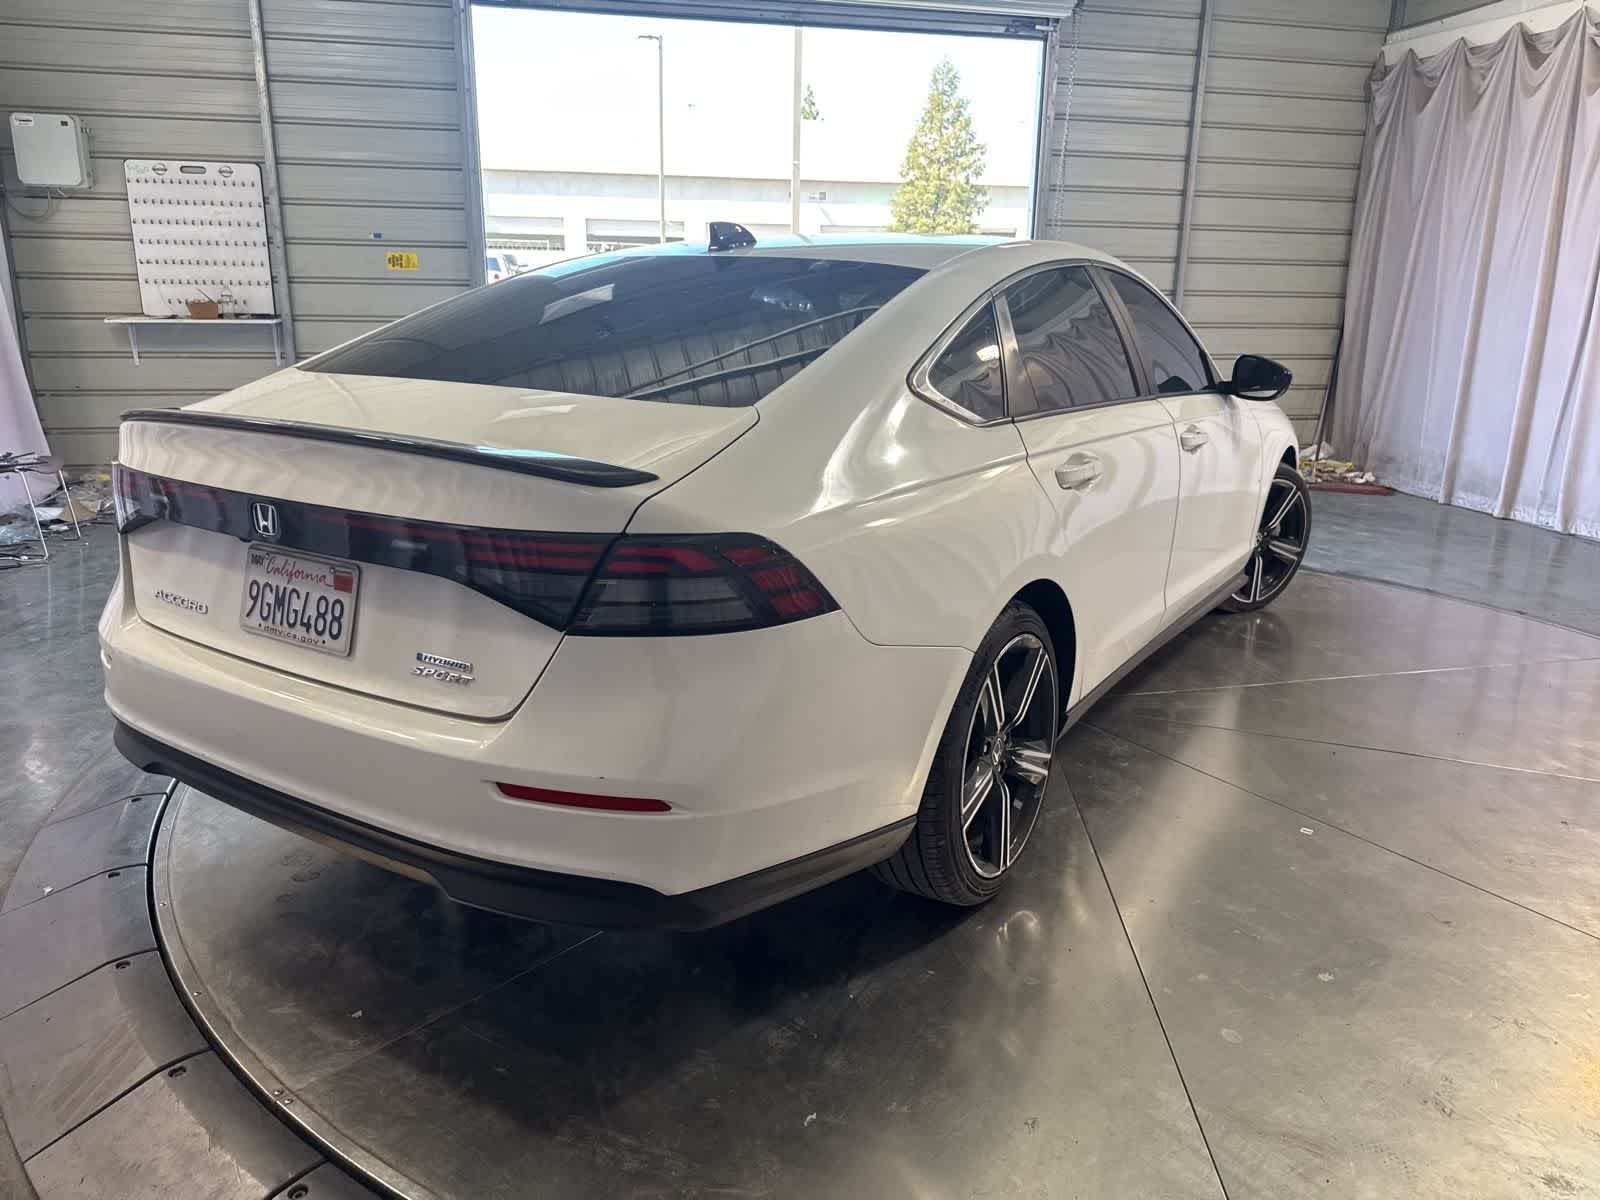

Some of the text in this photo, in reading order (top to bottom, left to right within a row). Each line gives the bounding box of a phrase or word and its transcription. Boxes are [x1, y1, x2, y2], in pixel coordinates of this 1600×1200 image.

[266, 556, 328, 585] California
[246, 579, 345, 641] 9GMG488
[263, 625, 320, 646] dmv.ca.gov
[423, 654, 472, 672] HYBRID
[413, 666, 475, 685] SPORT
